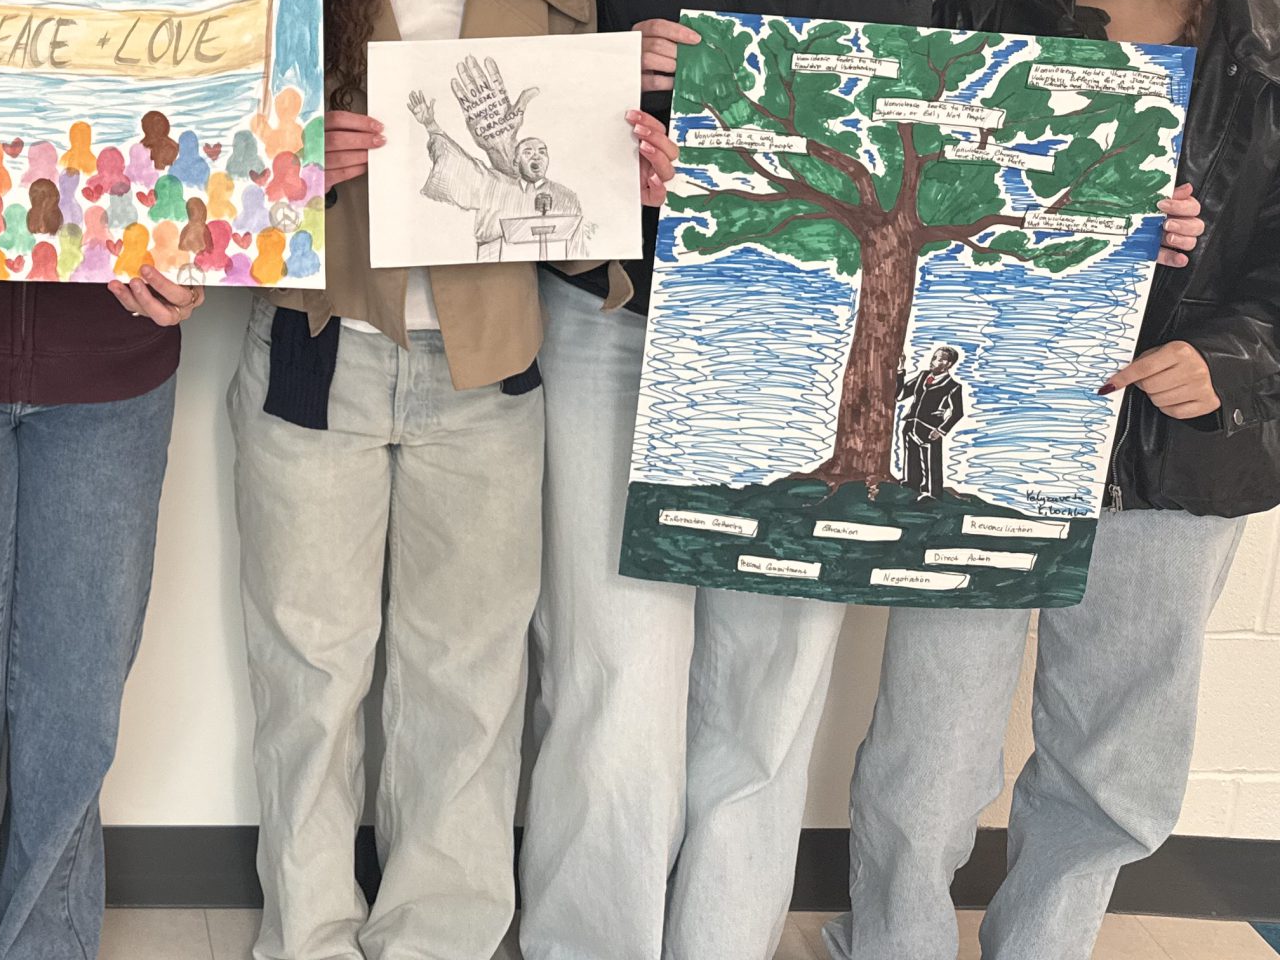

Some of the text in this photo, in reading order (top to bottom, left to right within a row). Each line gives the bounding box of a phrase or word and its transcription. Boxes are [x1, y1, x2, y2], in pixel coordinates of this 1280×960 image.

[114, 15, 228, 67] LOVE
[483, 123, 515, 141] PEOPLE
[883, 573, 930, 585] Negotiation
